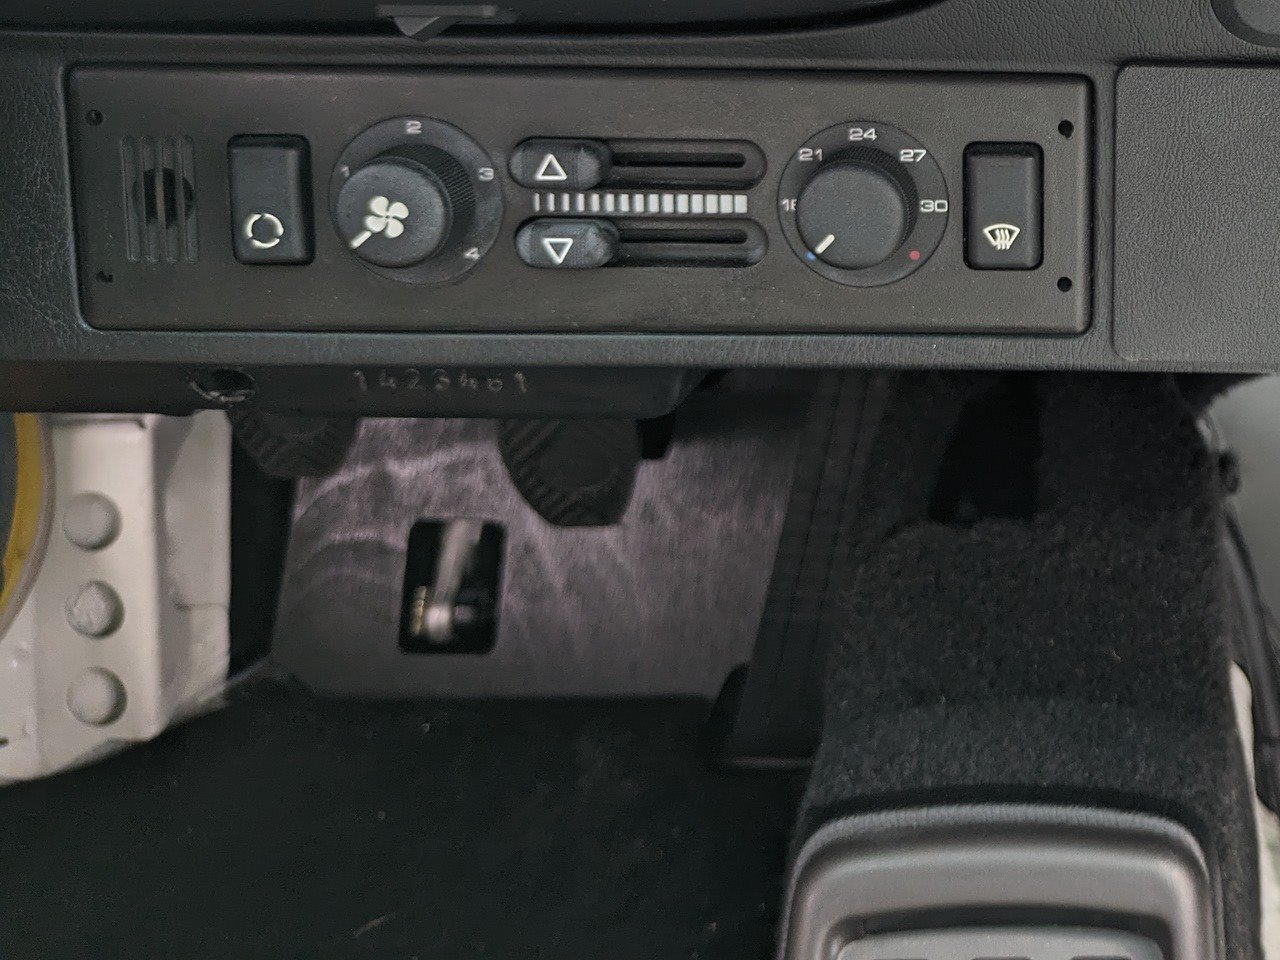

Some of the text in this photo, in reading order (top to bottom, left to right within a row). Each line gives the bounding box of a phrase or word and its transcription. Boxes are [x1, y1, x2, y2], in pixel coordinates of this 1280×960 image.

[405, 120, 423, 135] 2
[849, 127, 878, 141] 24
[798, 148, 824, 162] 21
[899, 148, 927, 163] 27
[340, 165, 351, 178] 1
[477, 166, 495, 182] 3
[919, 199, 949, 213] 30
[462, 246, 482, 261] 4
